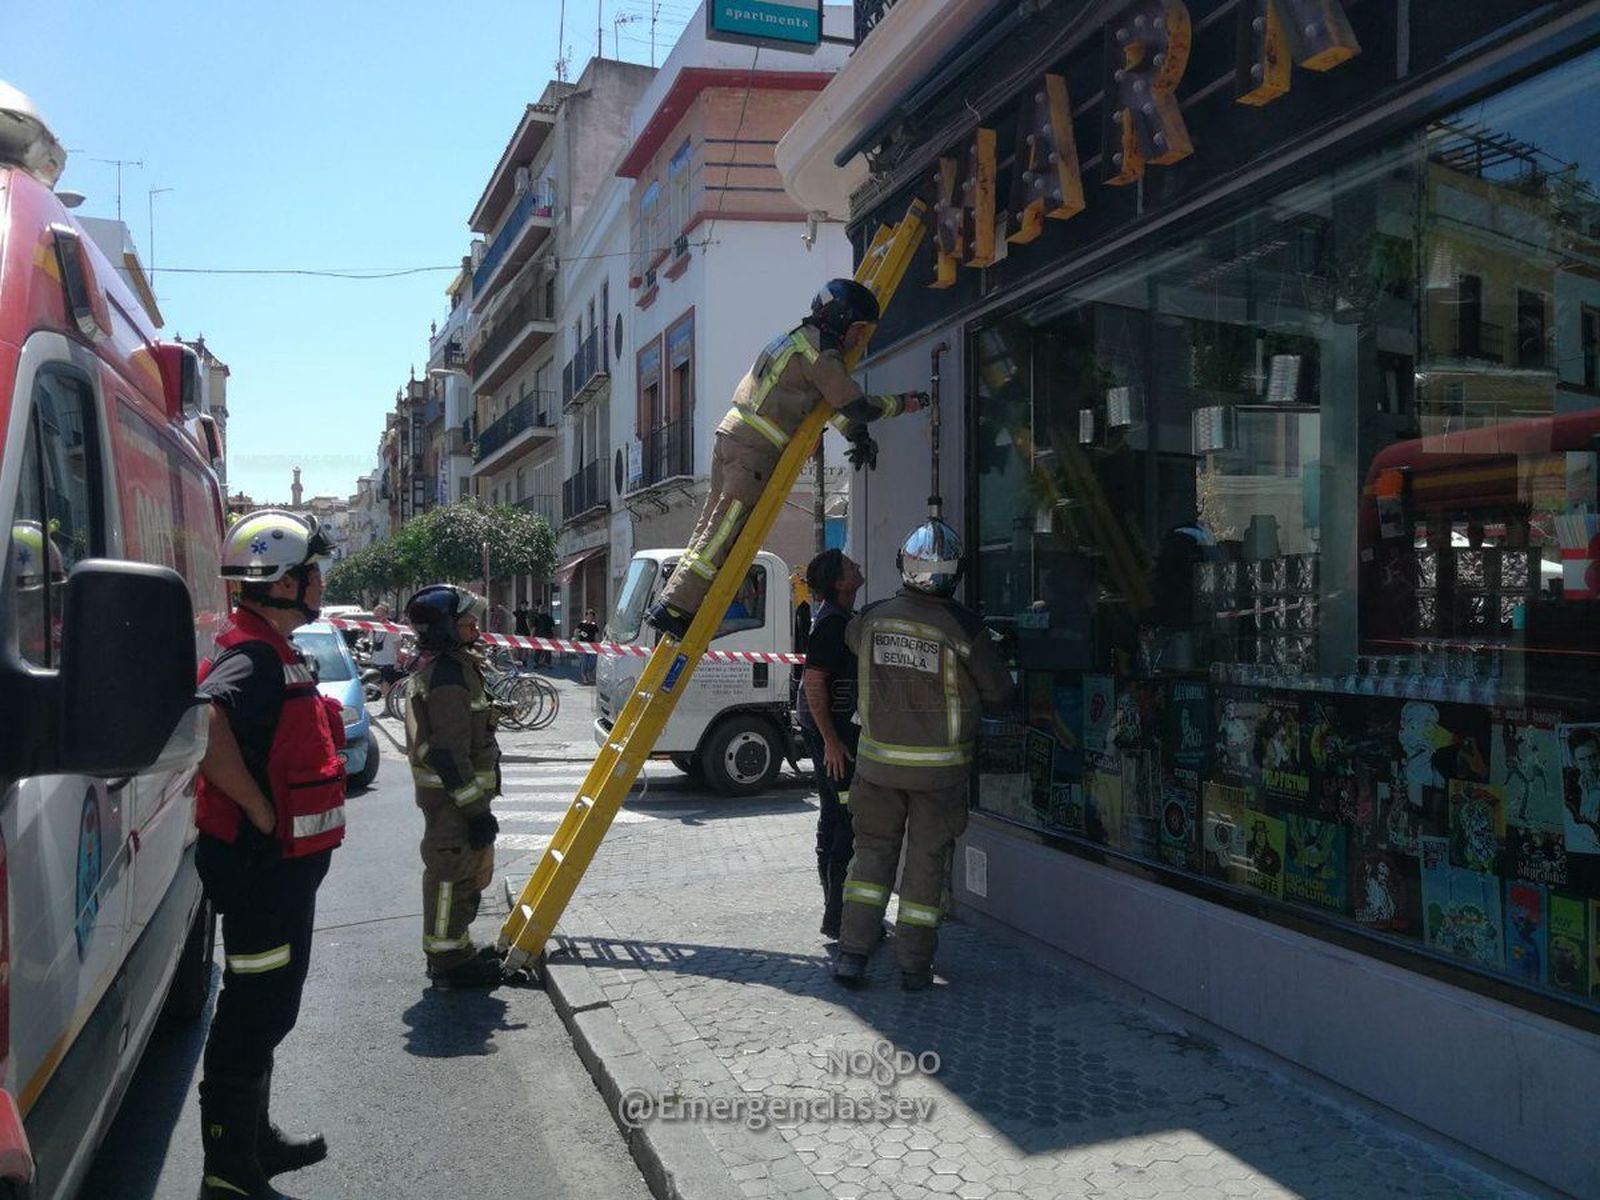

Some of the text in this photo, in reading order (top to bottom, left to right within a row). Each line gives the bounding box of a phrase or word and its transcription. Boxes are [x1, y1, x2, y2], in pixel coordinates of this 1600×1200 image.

[725, 7, 809, 28] apartments
[875, 634, 939, 655] BOMBEROS
[883, 651, 929, 669] SEVILLA
